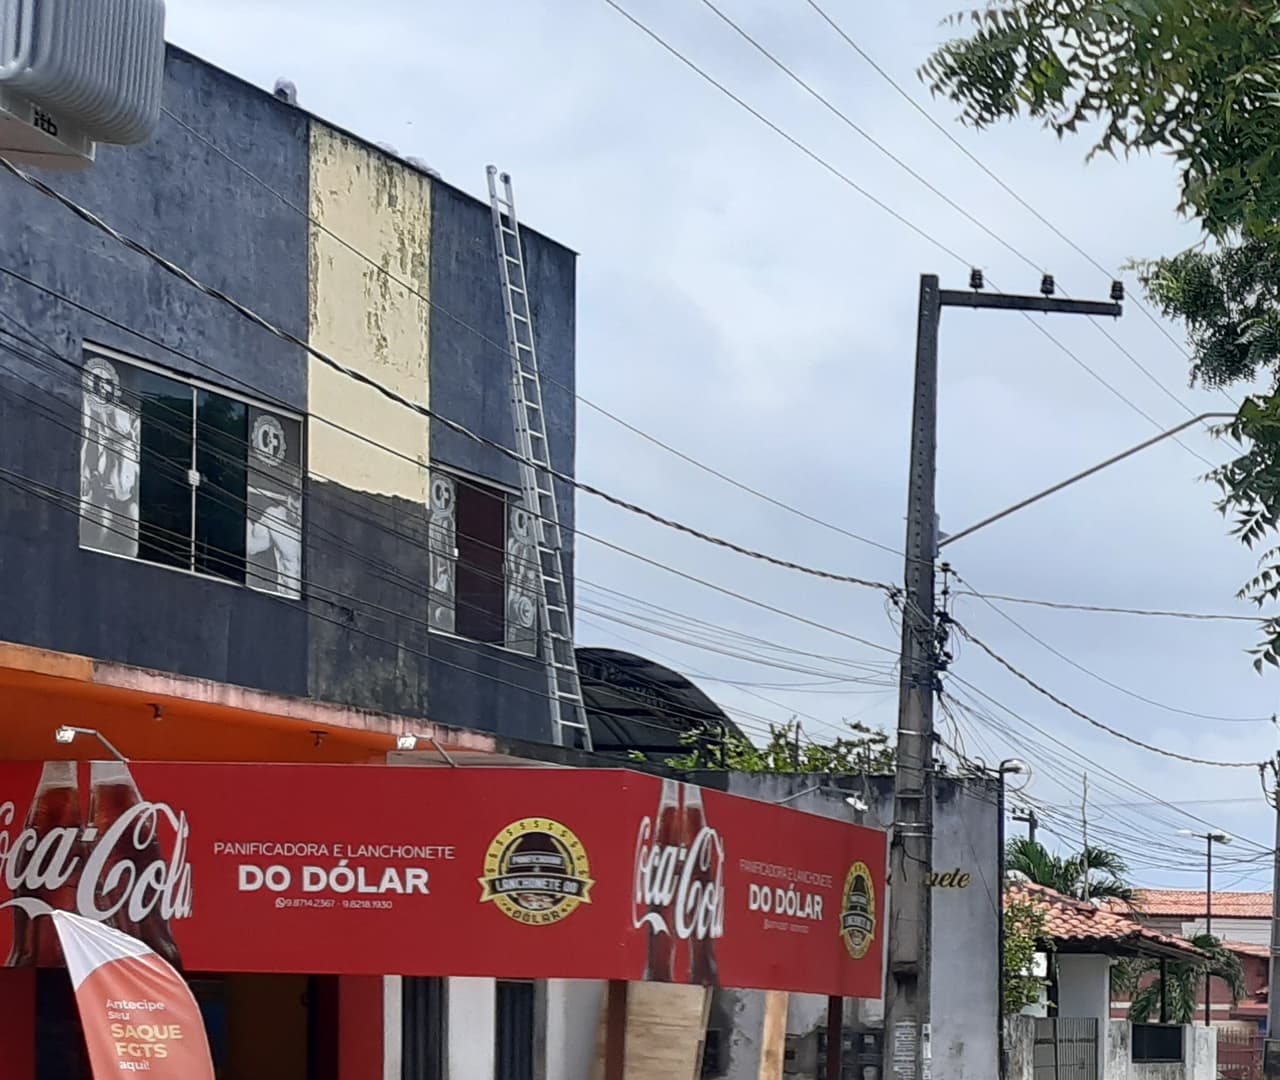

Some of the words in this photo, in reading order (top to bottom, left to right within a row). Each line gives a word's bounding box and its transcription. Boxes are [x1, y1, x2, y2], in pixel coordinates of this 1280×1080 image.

[213, 842, 329, 856] PANIFICADORA
[333, 844, 344, 857] E
[347, 844, 456, 860] LANCHONETE
[238, 864, 291, 892] DO
[302, 858, 430, 894] DÓLAR
[749, 883, 772, 912] DO
[775, 882, 823, 920] DÓLAR
[105, 999, 166, 1012] Antecipe
[107, 1011, 130, 1021] seu
[111, 1023, 183, 1043] SAQUE
[115, 1042, 168, 1059] FGTS
